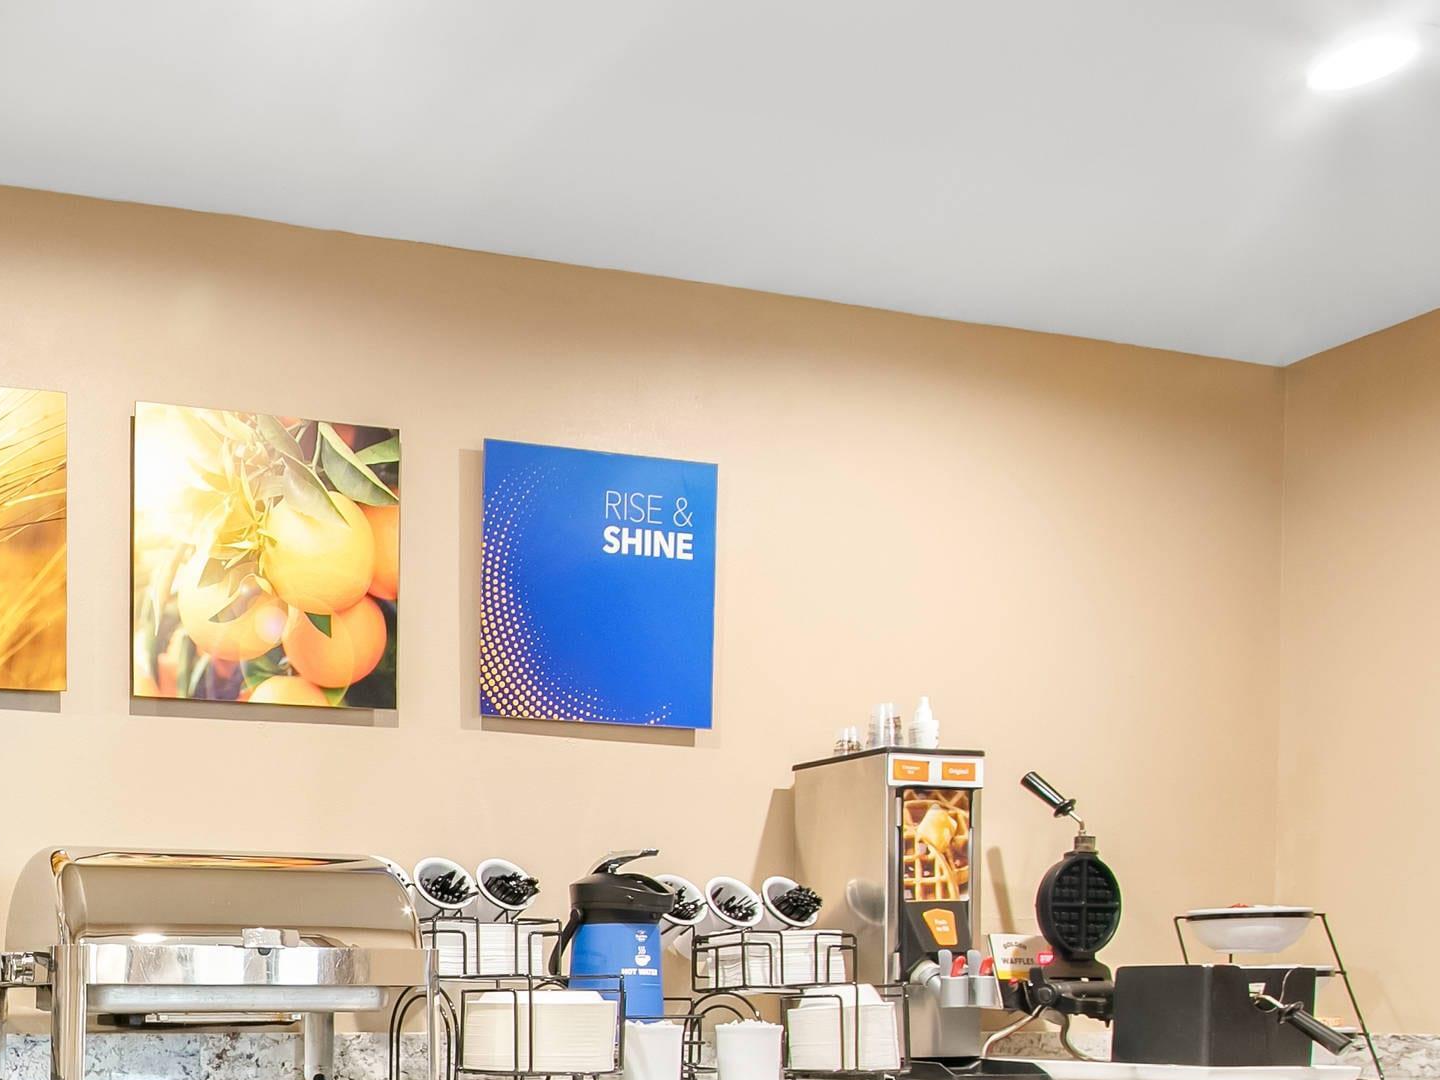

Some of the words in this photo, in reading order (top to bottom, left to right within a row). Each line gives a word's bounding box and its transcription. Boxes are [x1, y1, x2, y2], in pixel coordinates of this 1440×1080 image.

[605, 490, 663, 525] RISE
[673, 497, 693, 528] &
[602, 525, 694, 561] SHINE
